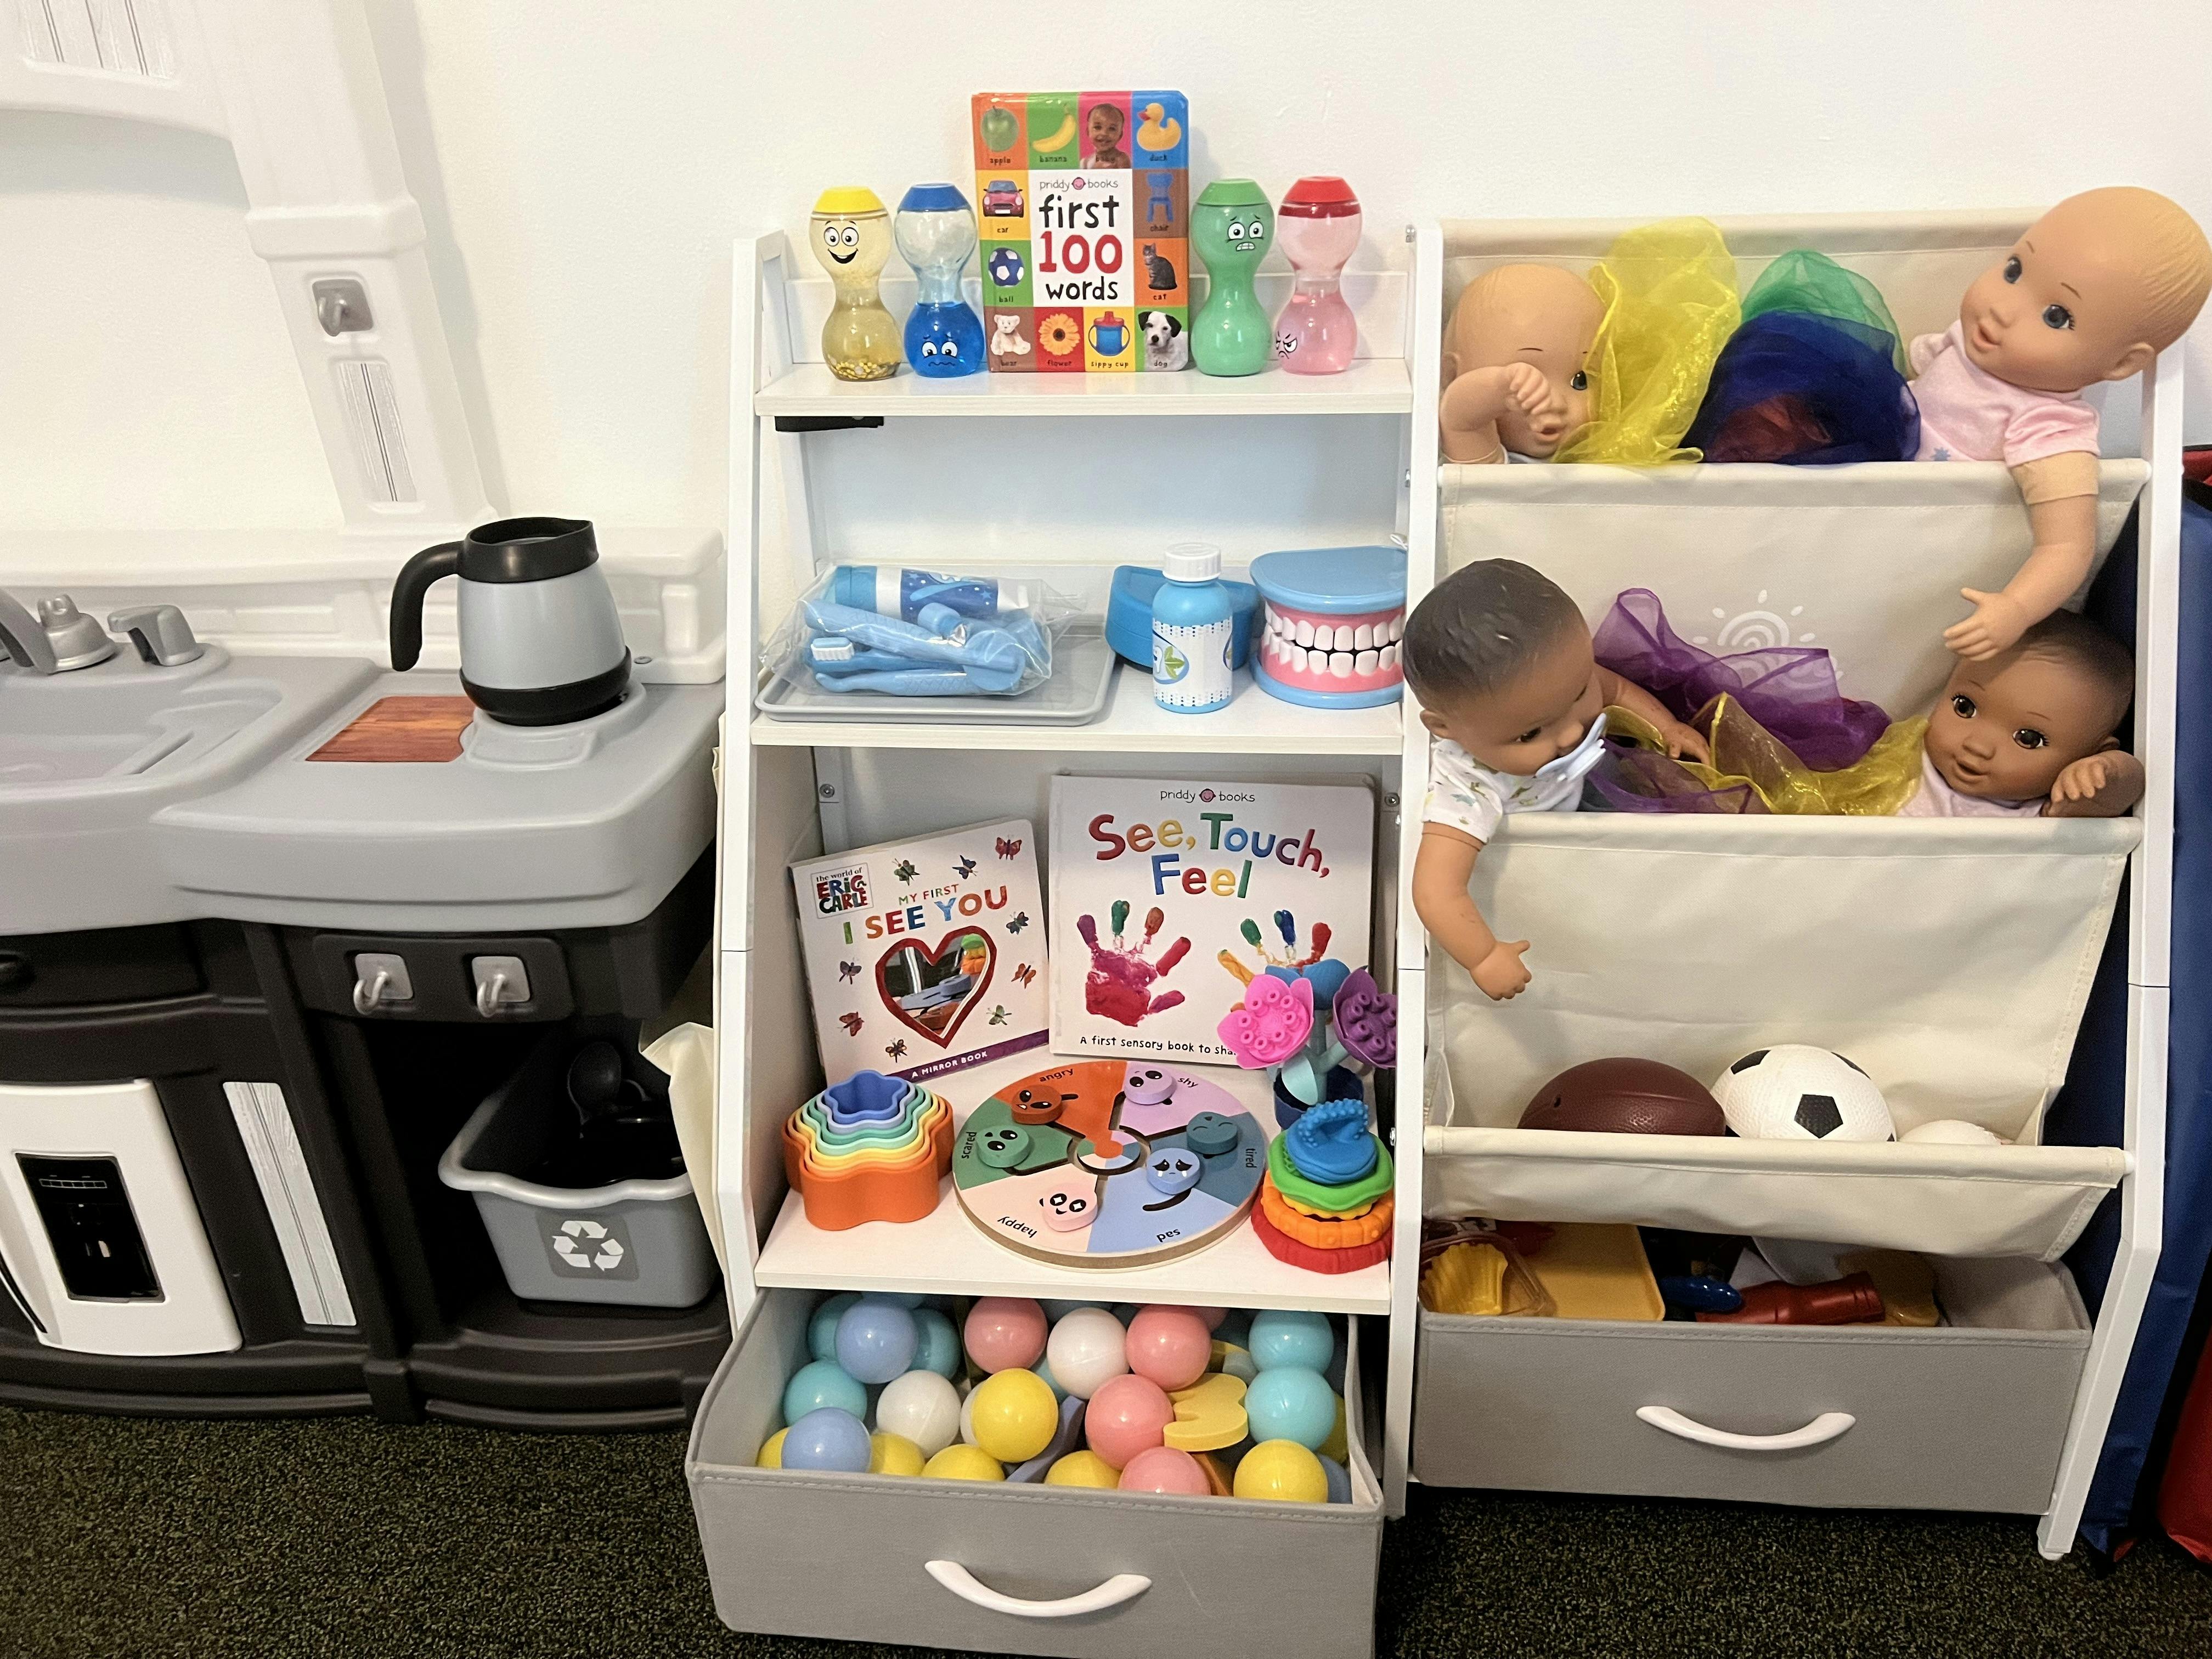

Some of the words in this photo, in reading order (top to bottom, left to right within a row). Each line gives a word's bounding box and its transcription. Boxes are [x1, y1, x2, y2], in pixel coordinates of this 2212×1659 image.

[1039, 179, 1070, 192] priddy
[1087, 179, 1119, 188] books
[1039, 194, 1120, 229] first
[1039, 231, 1122, 274] 100
[1046, 276, 1119, 301] words
[1153, 360, 1168, 368] dog
[1160, 790, 1196, 803] priddy
[1219, 792, 1256, 802] books
[1088, 814, 1196, 861] See,
[1200, 812, 1330, 878] Touch,
[831, 869, 853, 879] world
[1152, 853, 1252, 899] Feel
[819, 888, 868, 914] CARLE
[899, 893, 918, 905] MY
[923, 884, 959, 900] FIRST
[843, 921, 854, 945] I
[865, 905, 926, 939] SEE
[934, 885, 1008, 922] YOU
[1080, 1036, 1087, 1045] A
[1091, 1035, 1116, 1047] first
[1121, 1039, 1163, 1051] sensory
[1167, 1040, 1194, 1052] book
[1198, 1043, 1211, 1054] to
[911, 1070, 919, 1079] A
[921, 1059, 958, 1076] MIRROR
[961, 1050, 988, 1064] BOOK
[1039, 1068, 1074, 1083] angry
[1177, 1075, 1199, 1088] shy
[961, 1131, 978, 1160] scared
[1244, 1148, 1257, 1169] tired
[996, 1216, 1038, 1239] happy
[1156, 1228, 1181, 1243] sad
